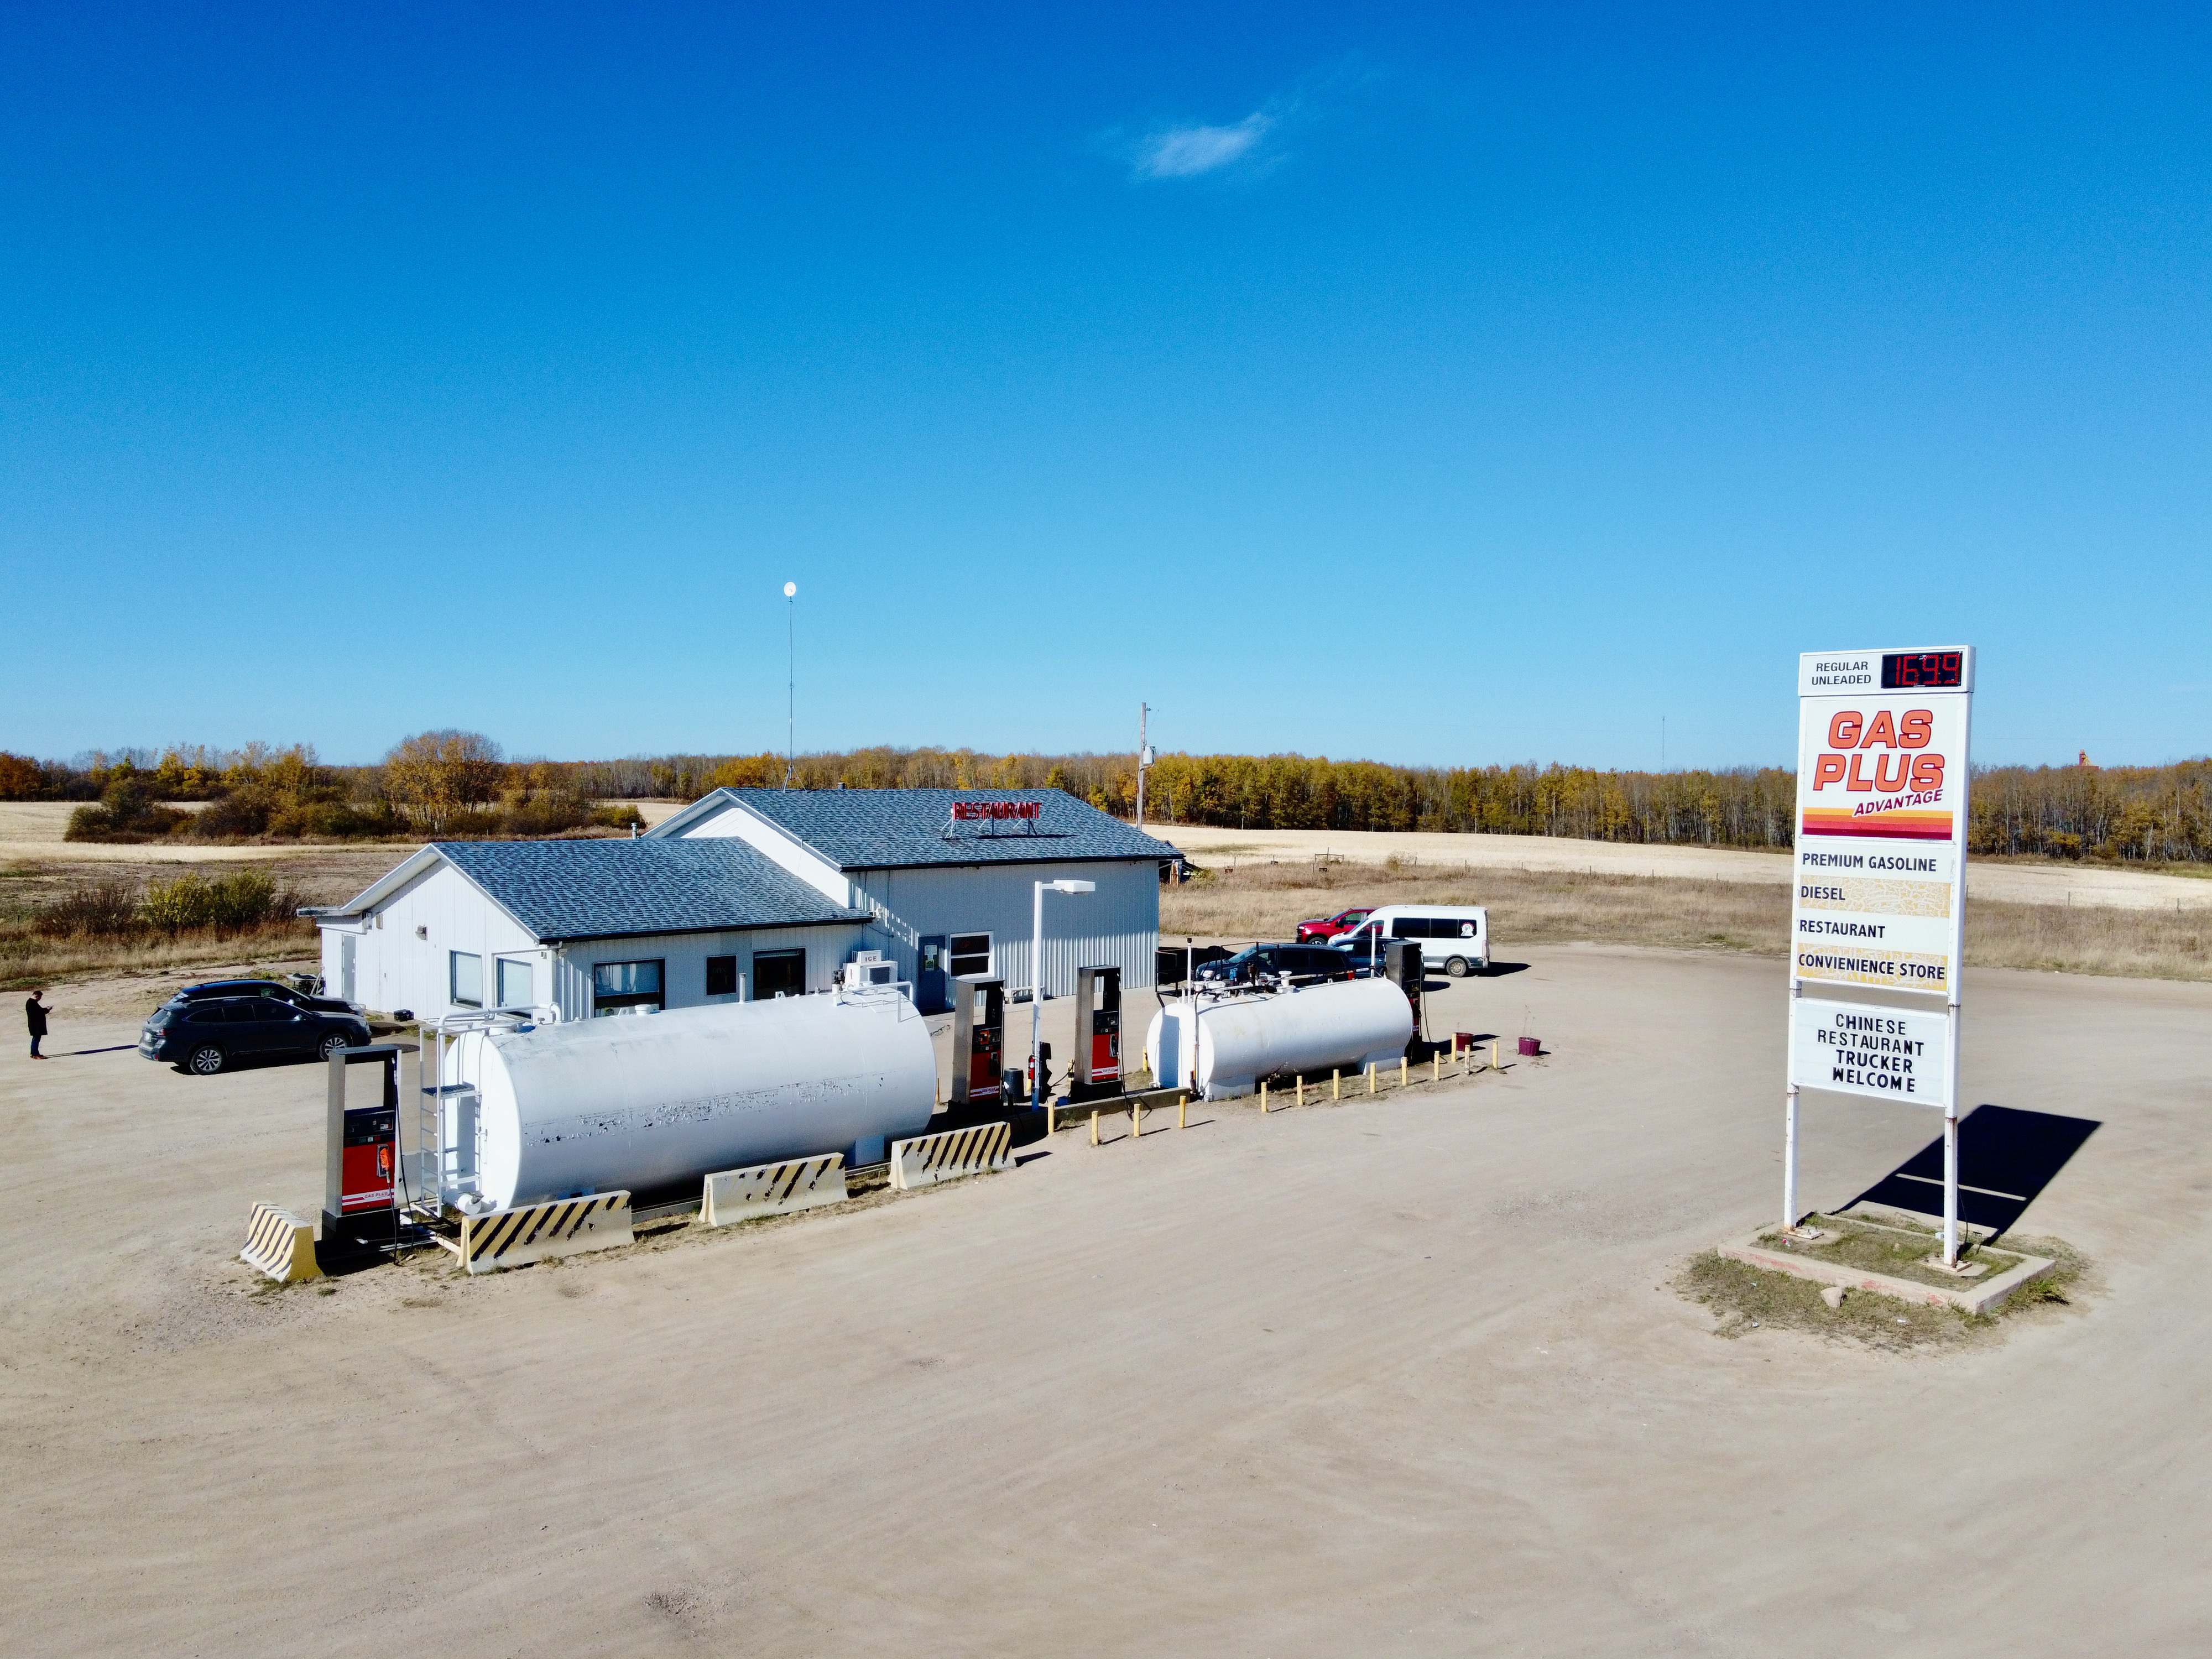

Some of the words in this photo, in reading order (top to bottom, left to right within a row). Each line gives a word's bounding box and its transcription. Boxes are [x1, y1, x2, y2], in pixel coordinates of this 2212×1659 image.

[1816, 661, 1868, 672] REGULAR
[1812, 675, 1871, 685] UNLEADED
[1828, 709, 1933, 749] GAS
[1813, 754, 1945, 792] PLUS
[952, 802, 1042, 820] RESTAURANT
[1854, 789, 1943, 816] ADVANTAGE
[1802, 853, 1864, 868] PREMIUM
[1869, 856, 1937, 872] GASOLINE
[1801, 885, 1846, 901] DIESEL
[1799, 919, 1886, 938] RESTAURANT
[1798, 953, 1895, 975] CONVIENIENCE
[1900, 963, 1945, 980] STORE
[1836, 1013, 1906, 1035] CHINESE
[1818, 1029, 1924, 1056] RESTAURANT
[1836, 1049, 1913, 1074] TRUCKER
[1832, 1067, 1916, 1093] WELCOME
